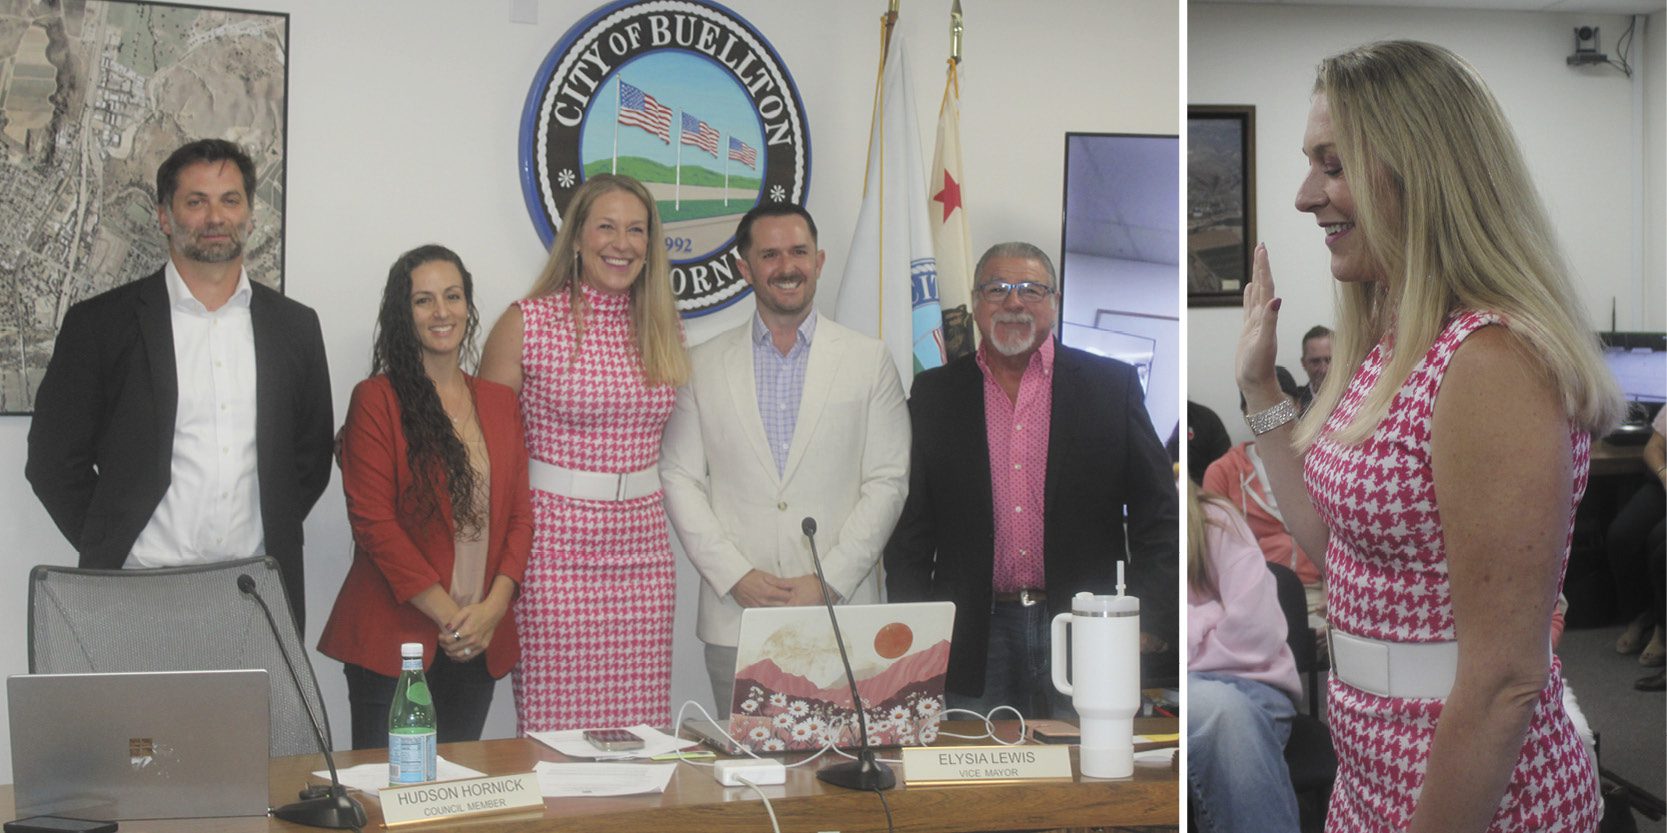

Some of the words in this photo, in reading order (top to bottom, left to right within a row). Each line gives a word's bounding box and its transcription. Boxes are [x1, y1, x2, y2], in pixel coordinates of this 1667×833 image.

[554, 41, 612, 127] CITY
[608, 22, 644, 57] OF
[649, 14, 793, 146] BUELLTON
[939, 753, 988, 765] ELYSIA
[991, 752, 1036, 764] LEWIS
[959, 769, 981, 778] VICE
[984, 768, 1019, 777] MAYOR
[398, 787, 459, 805] HUDSON
[461, 778, 525, 798] HORNICK
[424, 804, 464, 817] COUNCIL
[466, 798, 507, 811] MEMBER
